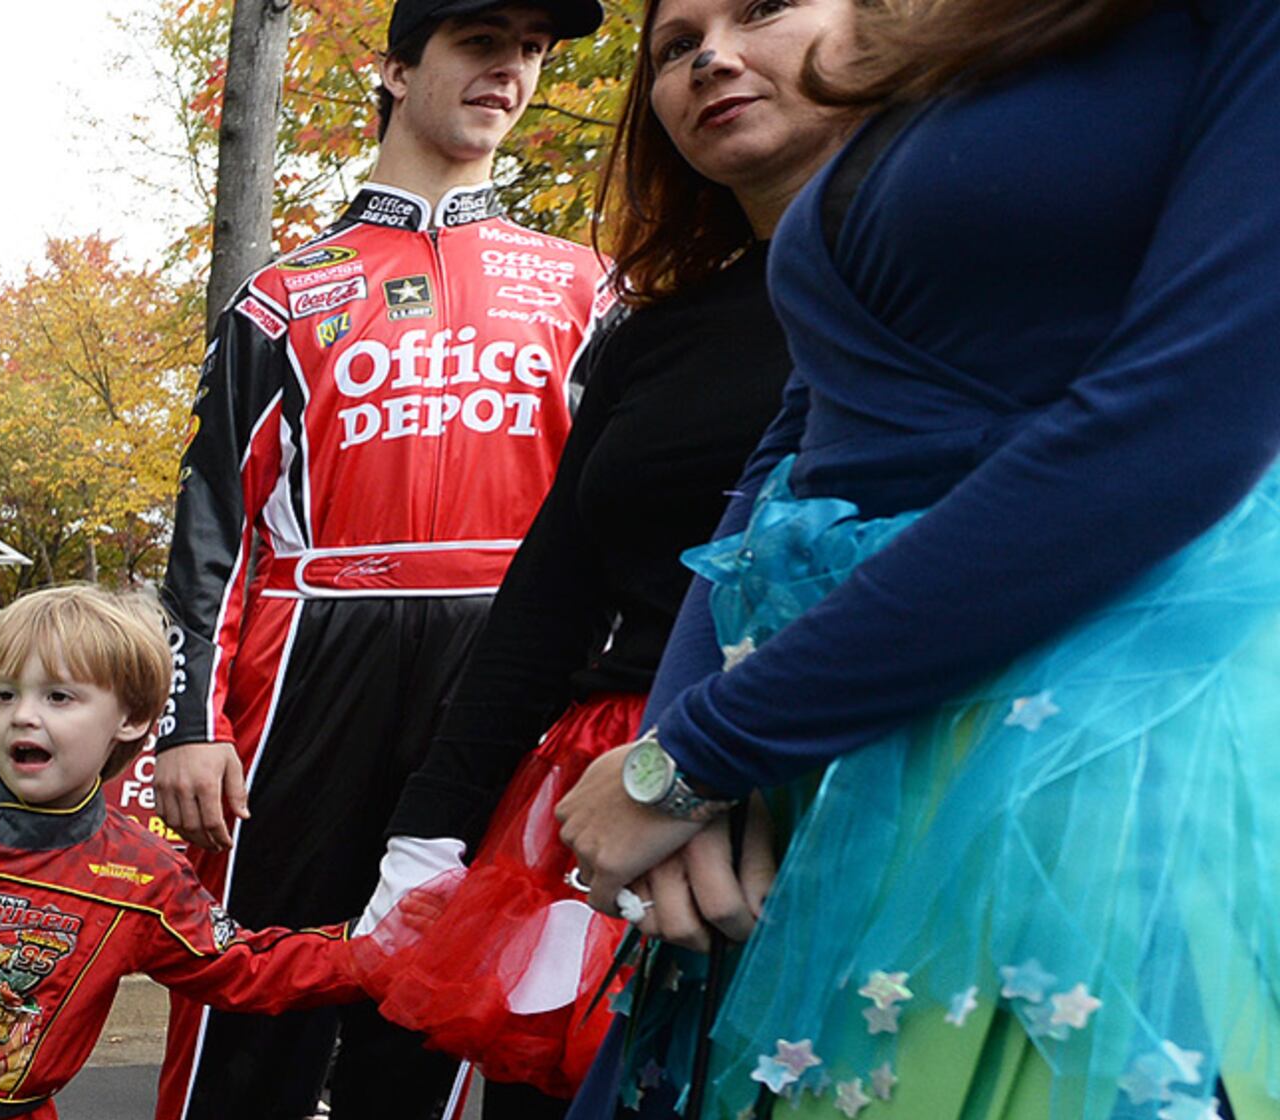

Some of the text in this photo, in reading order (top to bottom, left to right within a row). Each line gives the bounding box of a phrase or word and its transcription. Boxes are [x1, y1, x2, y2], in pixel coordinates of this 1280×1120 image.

[367, 195, 415, 216] Office
[359, 209, 409, 227] DEPOT
[478, 226, 545, 248] Mobil
[480, 250, 576, 273] Office
[482, 264, 575, 288] DEPOT
[333, 325, 554, 398] Office
[337, 388, 542, 450] DEPOT
[14, 944, 60, 975] 95
